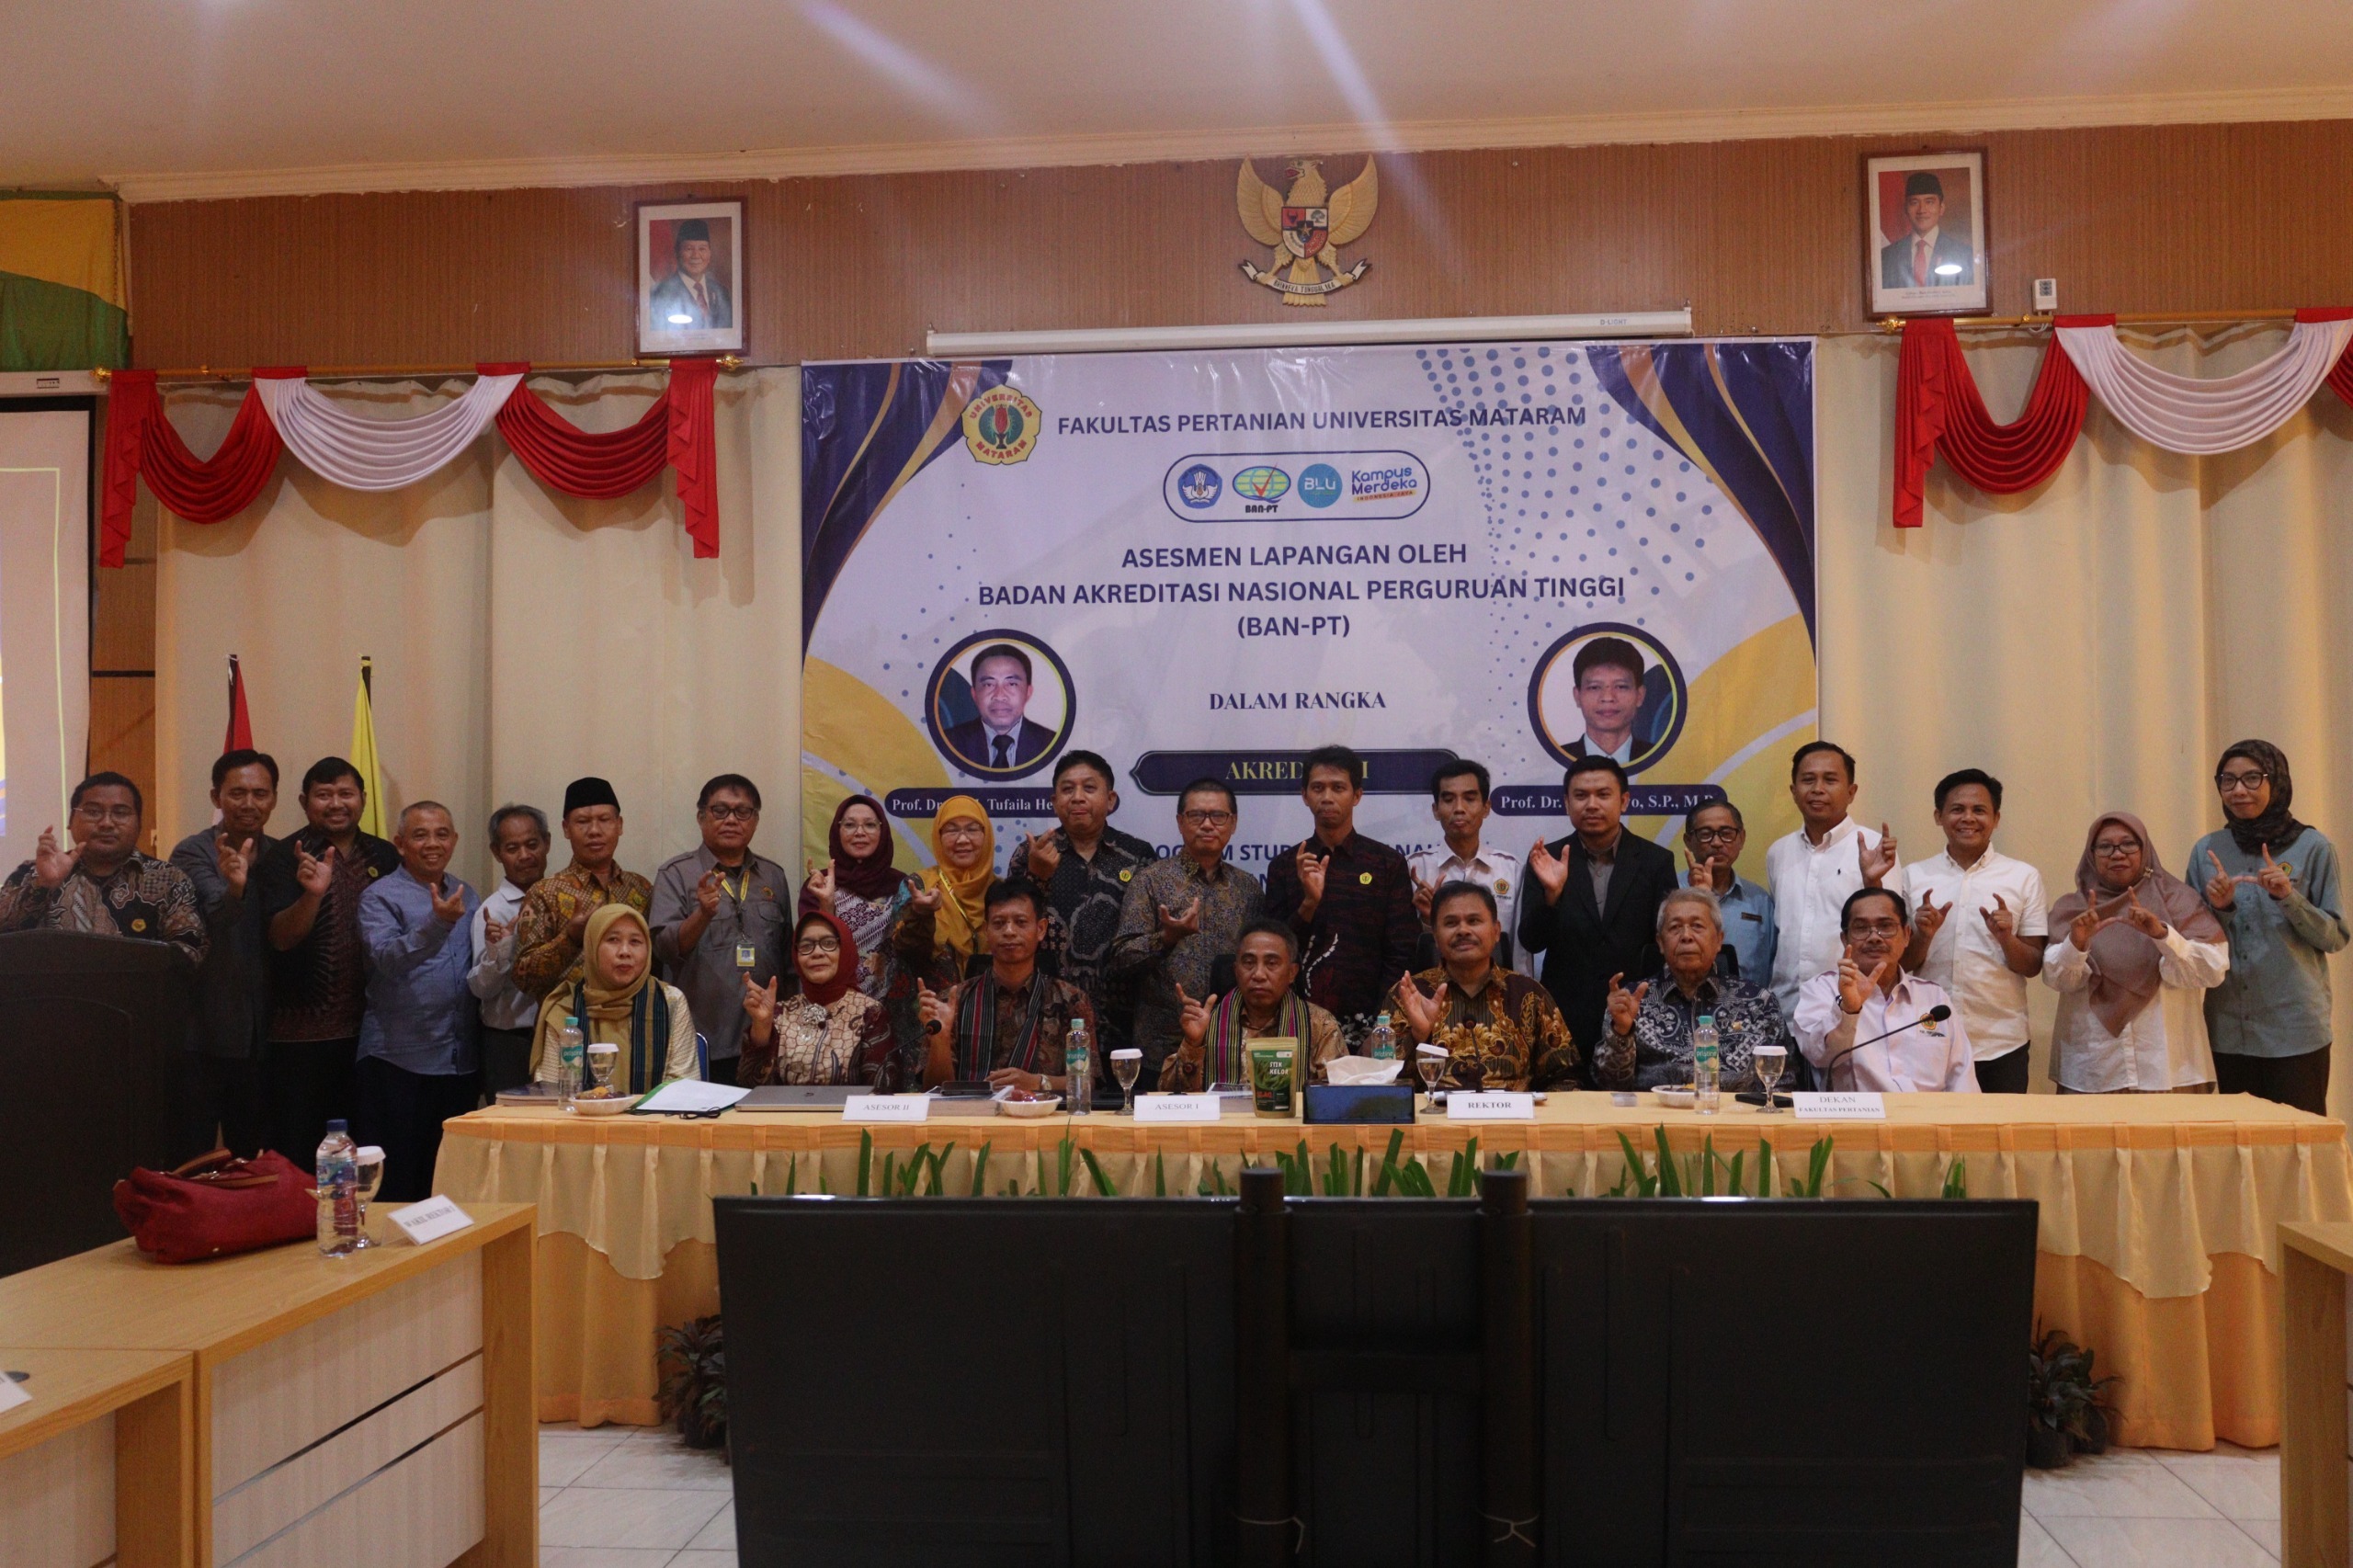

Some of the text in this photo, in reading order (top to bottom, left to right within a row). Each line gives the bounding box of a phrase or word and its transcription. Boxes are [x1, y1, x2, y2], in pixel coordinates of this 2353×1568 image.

[970, 393, 1032, 419] UNIVERSITAS
[1058, 406, 1586, 435] FAKULTAS PERTANIAN UNIVERSITAS MATARAM
[975, 439, 1027, 459] MATARAM
[1304, 477, 1336, 491] BLU
[1351, 467, 1412, 483] Kampus
[1351, 478, 1417, 495] Merdeka
[1357, 493, 1393, 501] INDONESIA
[1245, 505, 1279, 513] BAN-PT
[1121, 543, 1466, 568] ASESMEN LAPANGAN OLEH
[979, 576, 1624, 606] BADAN AKREDITASI NASIONAL PERGURUAN TINGGI
[1237, 615, 1350, 639] (BAN-PT)
[1210, 691, 1386, 710] DALAM RANGKA
[1225, 761, 1369, 780] AKREDI
[892, 798, 922, 811] Prof.
[987, 798, 1031, 811] Tufaila
[1501, 795, 1535, 809] Prof.
[1540, 795, 1562, 809] Dr.
[1648, 794, 1679, 809] S.P.,
[1819, 1096, 1856, 1104] DEKAN
